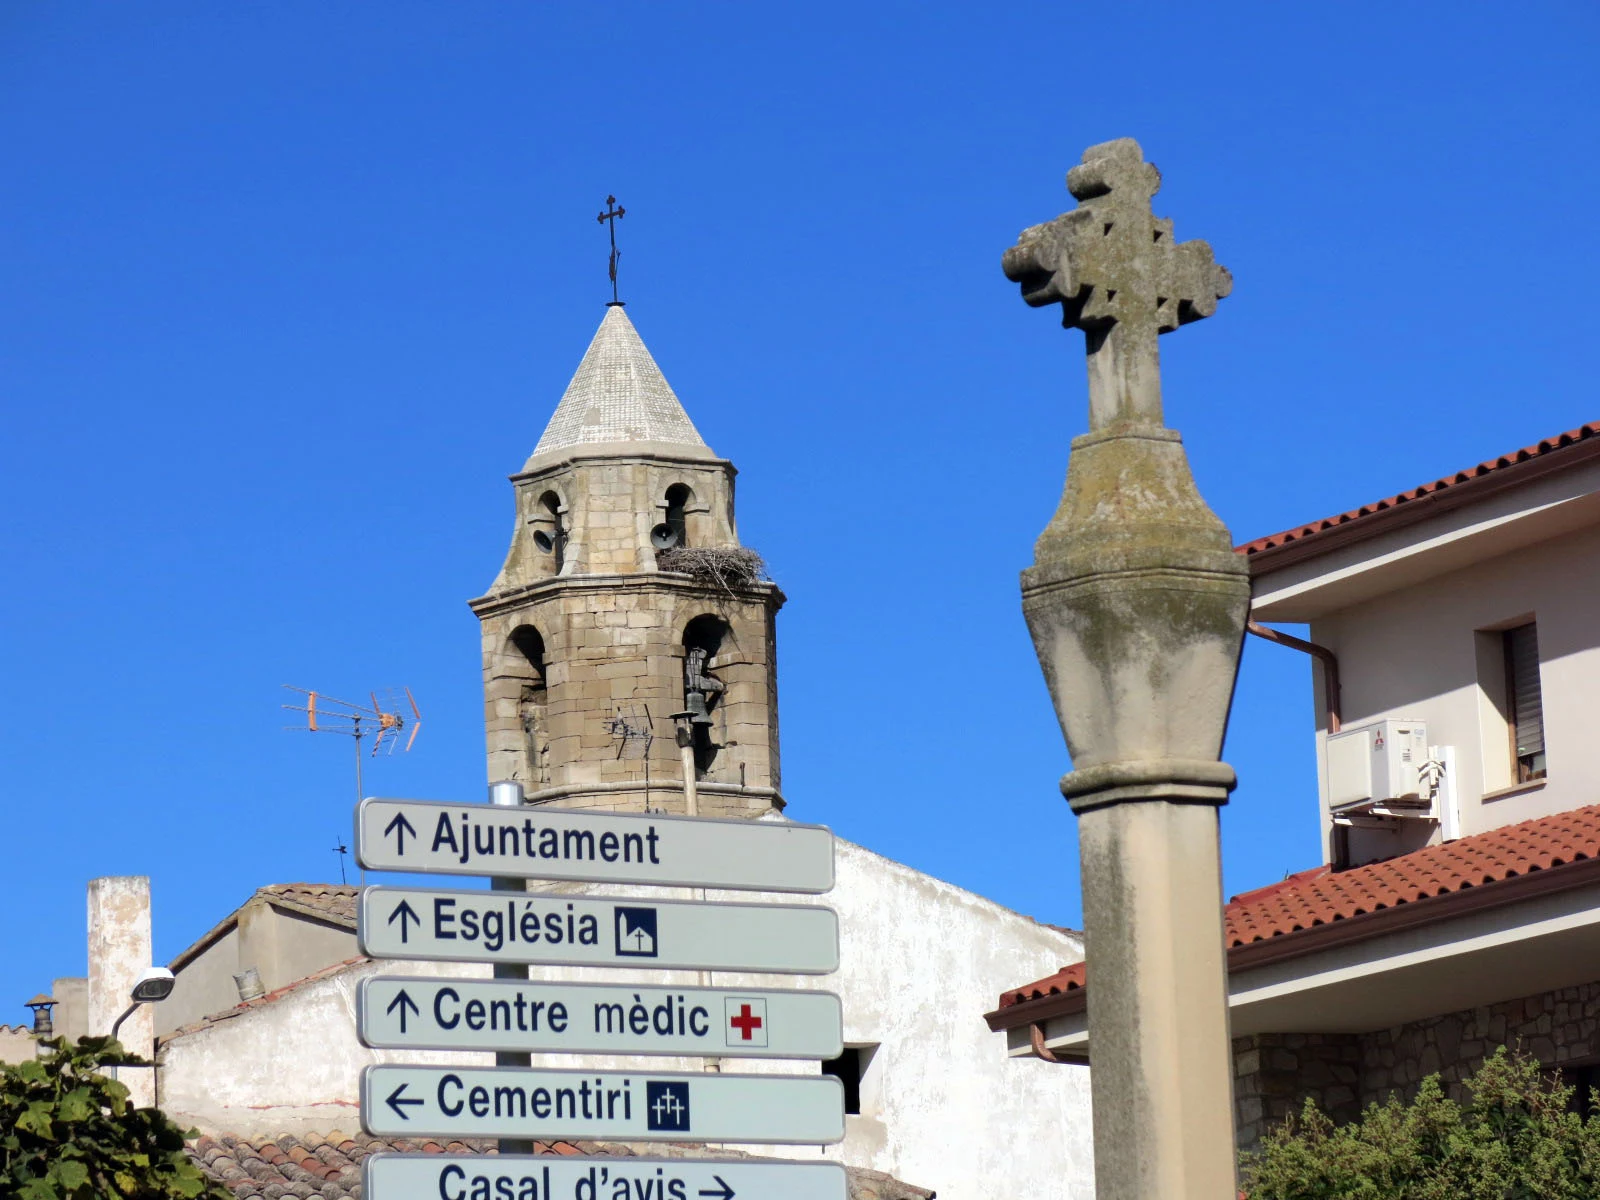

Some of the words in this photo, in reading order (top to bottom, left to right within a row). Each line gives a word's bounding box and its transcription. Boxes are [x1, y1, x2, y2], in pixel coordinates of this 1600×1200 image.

[431, 812, 660, 865] Ajuntament
[433, 898, 599, 951] Església
[433, 987, 569, 1032] Centre
[594, 994, 709, 1037] mèdic
[437, 1074, 632, 1120] Cementiri
[438, 1163, 550, 1200] Casal
